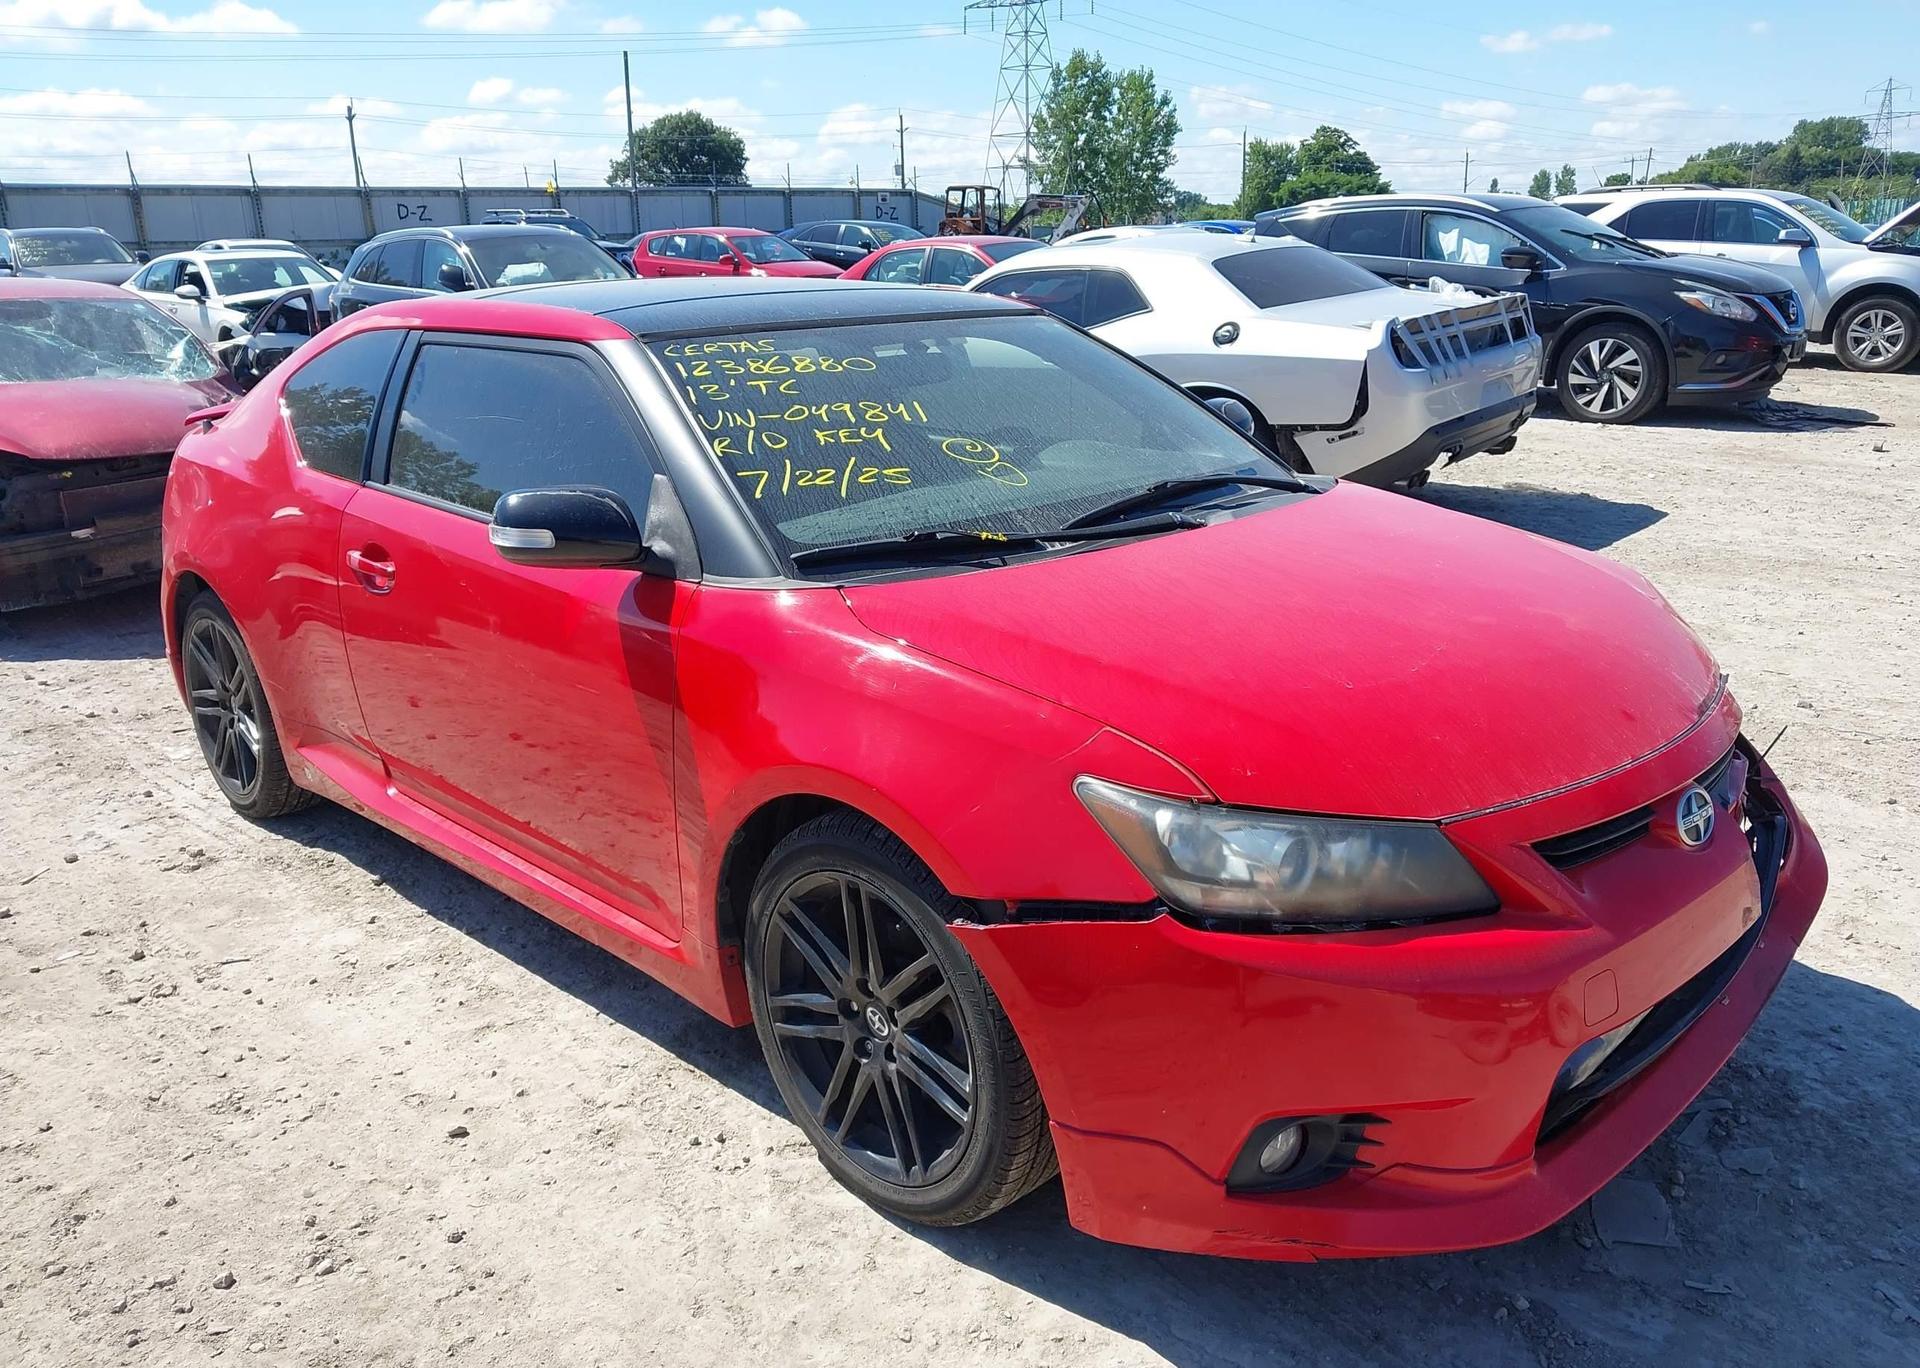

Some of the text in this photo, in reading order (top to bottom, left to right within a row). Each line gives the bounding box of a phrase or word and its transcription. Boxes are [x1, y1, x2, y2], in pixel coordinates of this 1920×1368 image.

[397, 203, 432, 221] D-Z
[876, 206, 898, 220] D-Z
[663, 340, 775, 356] CERTAS
[675, 356, 876, 379] 12386880
[698, 401, 928, 430] VIN-049841
[814, 427, 892, 451] KEY
[737, 457, 912, 499] 7/22/25
